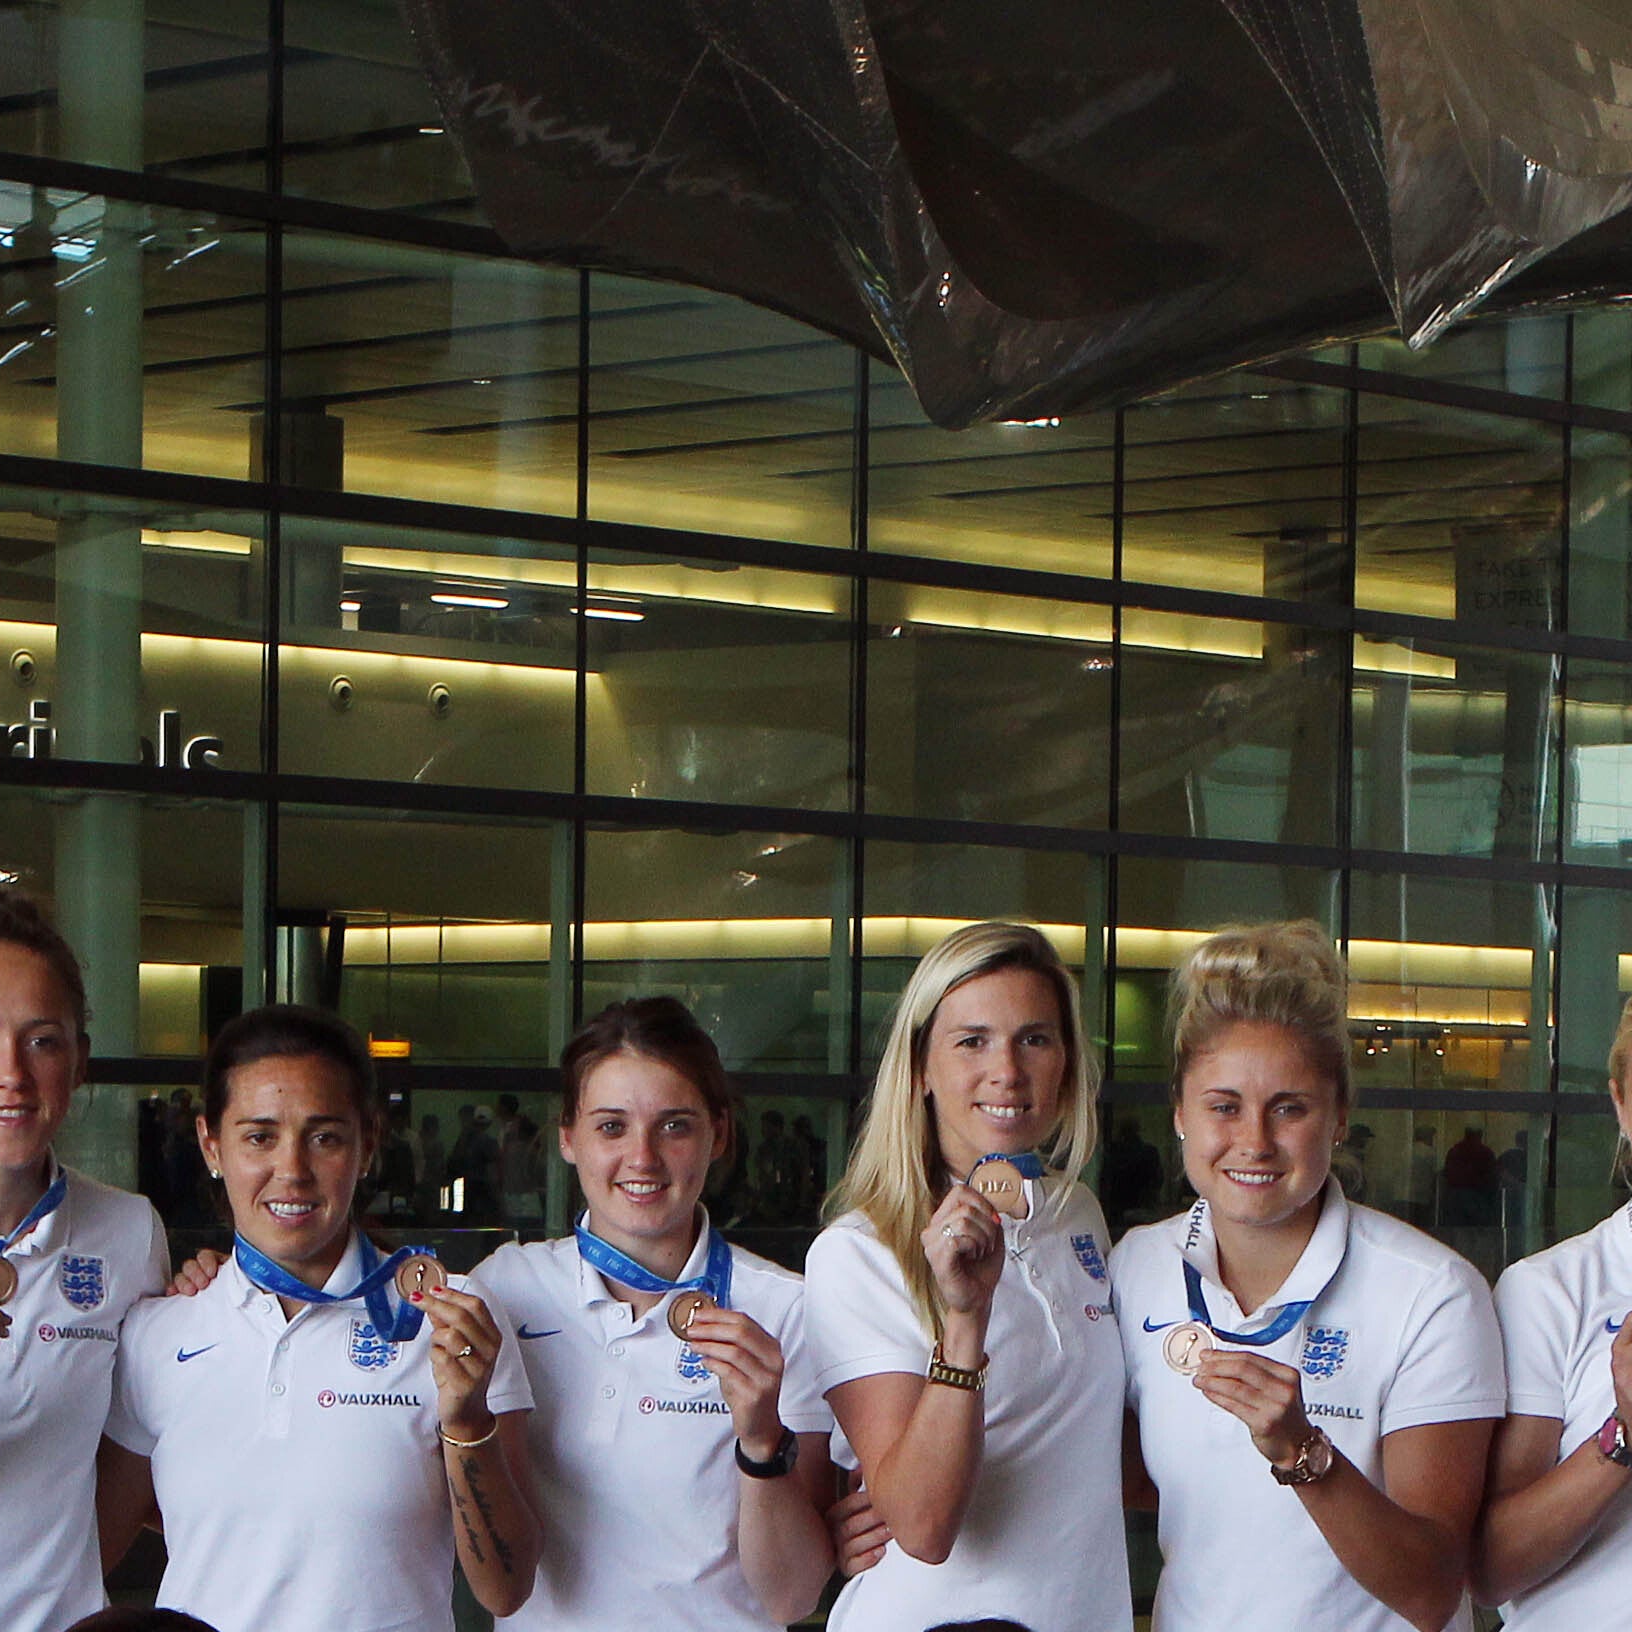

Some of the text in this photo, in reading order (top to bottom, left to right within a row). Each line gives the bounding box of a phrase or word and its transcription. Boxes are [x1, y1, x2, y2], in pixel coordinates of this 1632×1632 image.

[56, 1326, 119, 1343] VAUXHALL
[337, 1393, 422, 1407] VAUXHALL
[656, 1399, 732, 1416] VAUXHAL
[1303, 1402, 1365, 1421] UXHALL
